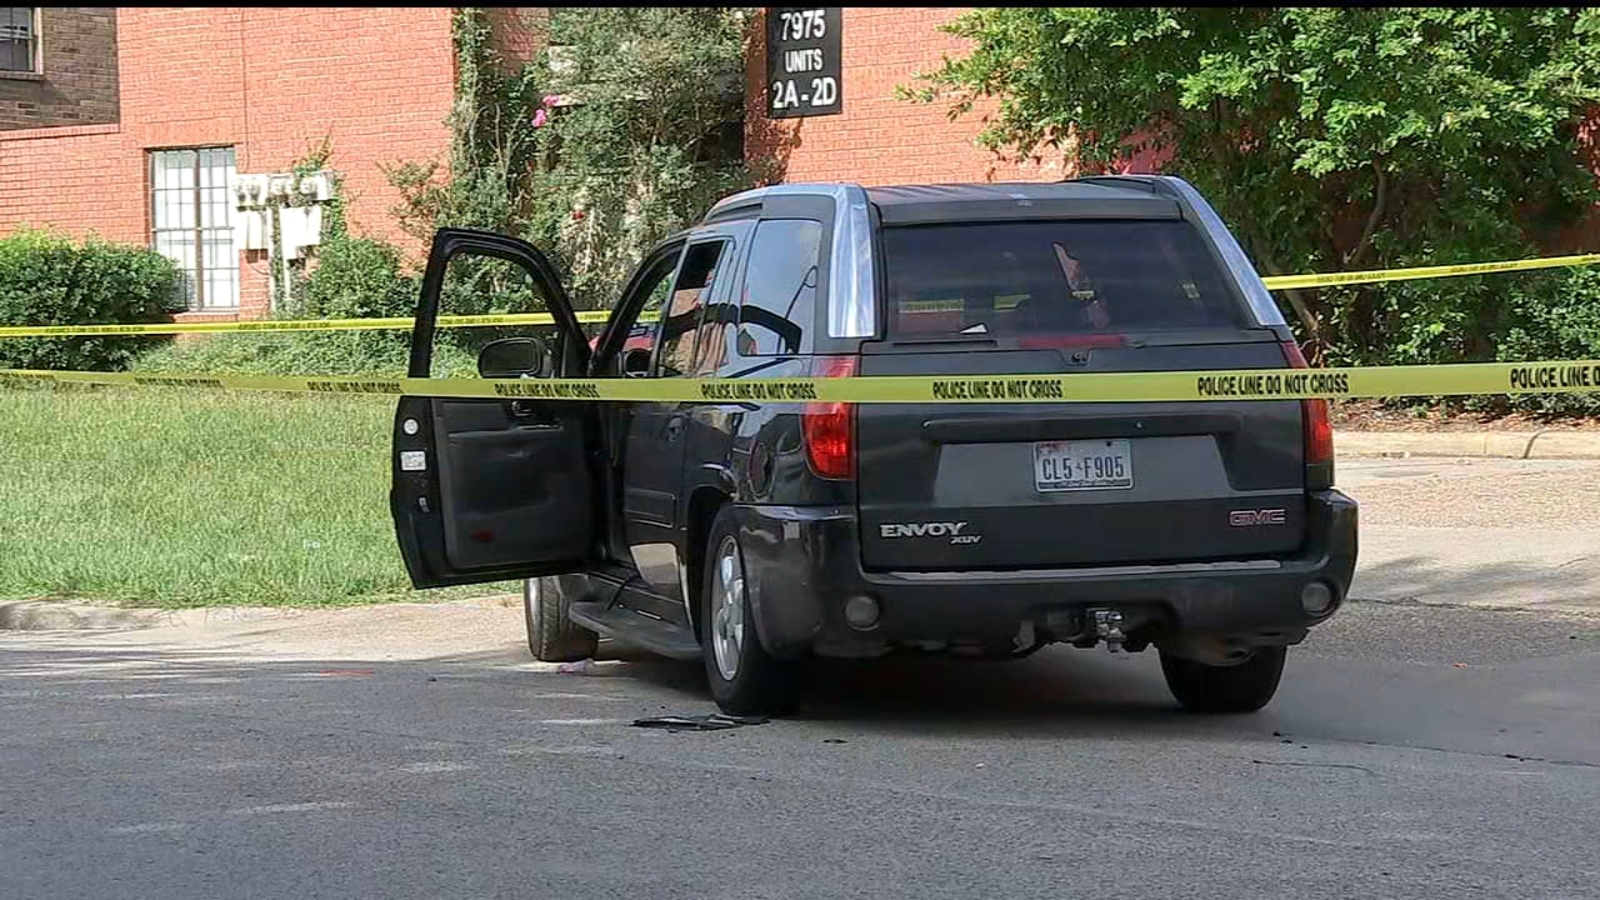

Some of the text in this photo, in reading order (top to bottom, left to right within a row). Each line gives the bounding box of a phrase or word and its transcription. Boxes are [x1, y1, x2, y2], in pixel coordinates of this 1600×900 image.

[780, 9, 826, 41] 7975
[784, 48, 823, 73] UNITS
[773, 79, 799, 110] 2A
[811, 76, 837, 107] 2D
[1197, 373, 1349, 396] POLICE LINE DO NOT CROSS
[1510, 367, 1557, 389] POLICE
[1560, 366, 1591, 387] LINE
[494, 383, 601, 398] POLICE LINE DO NOT CROSS
[701, 382, 818, 400] POLICE LINE DO NOT CROSS
[932, 379, 1063, 399] POLICE LINE DO NOT CROSS
[1043, 455, 1125, 480] CL5 F905
[1230, 509, 1286, 526] GMC
[880, 522, 967, 538] ENVOY
[950, 535, 981, 545] XUV
